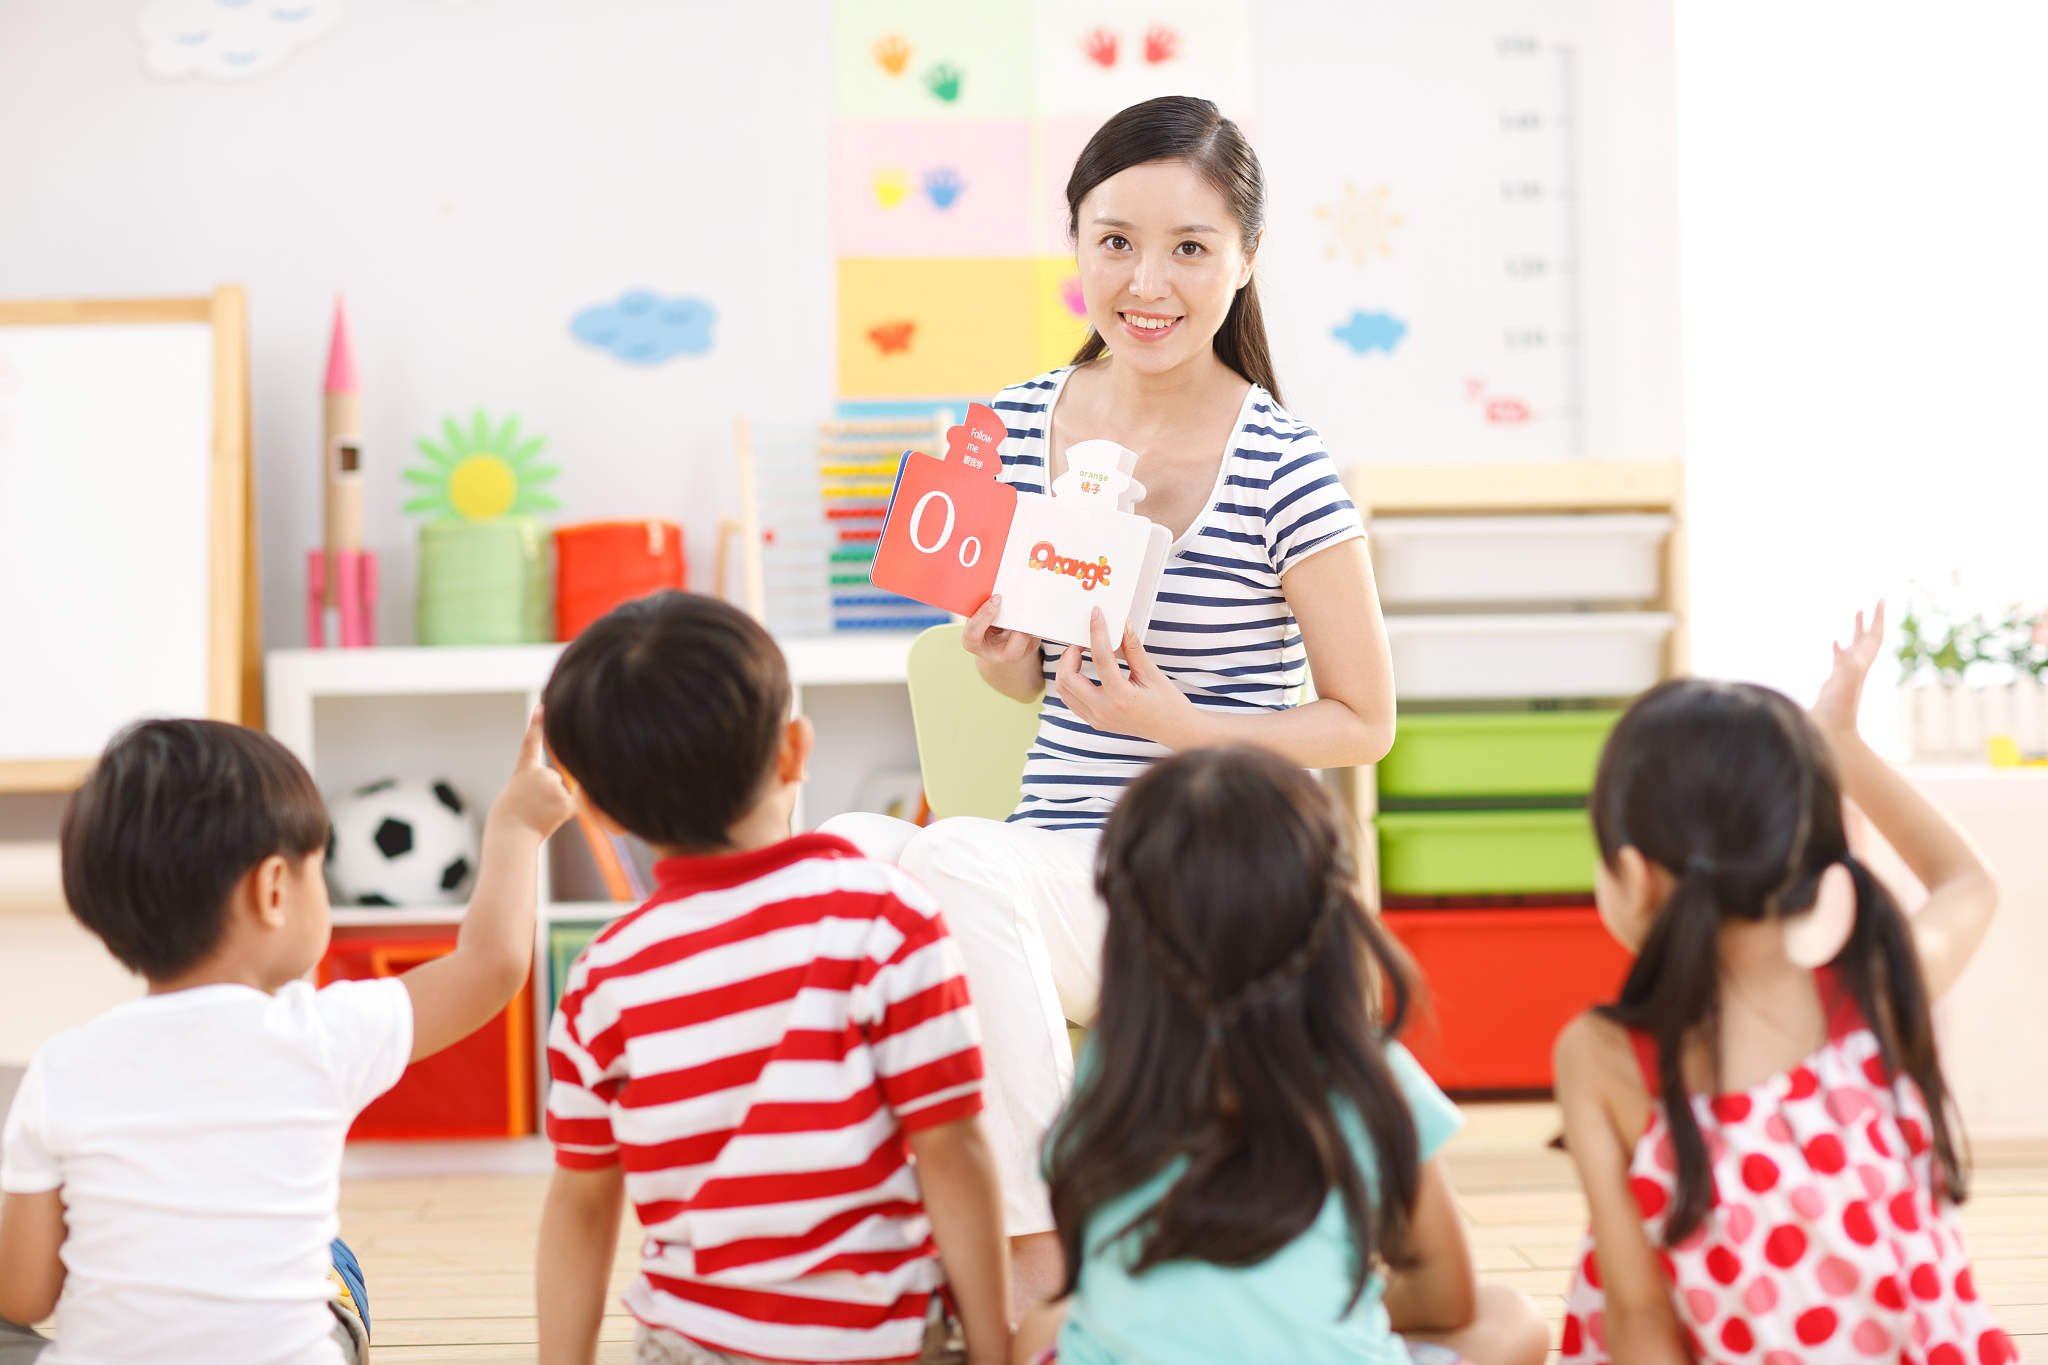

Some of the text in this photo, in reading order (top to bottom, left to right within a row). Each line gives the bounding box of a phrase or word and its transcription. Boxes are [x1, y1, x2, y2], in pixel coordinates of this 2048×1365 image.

[970, 427, 993, 443] Follow
[966, 443, 979, 453] me
[1079, 470, 1109, 482] orange
[1081, 481, 1101, 495] 橘子
[1029, 541, 1111, 590] Orange
